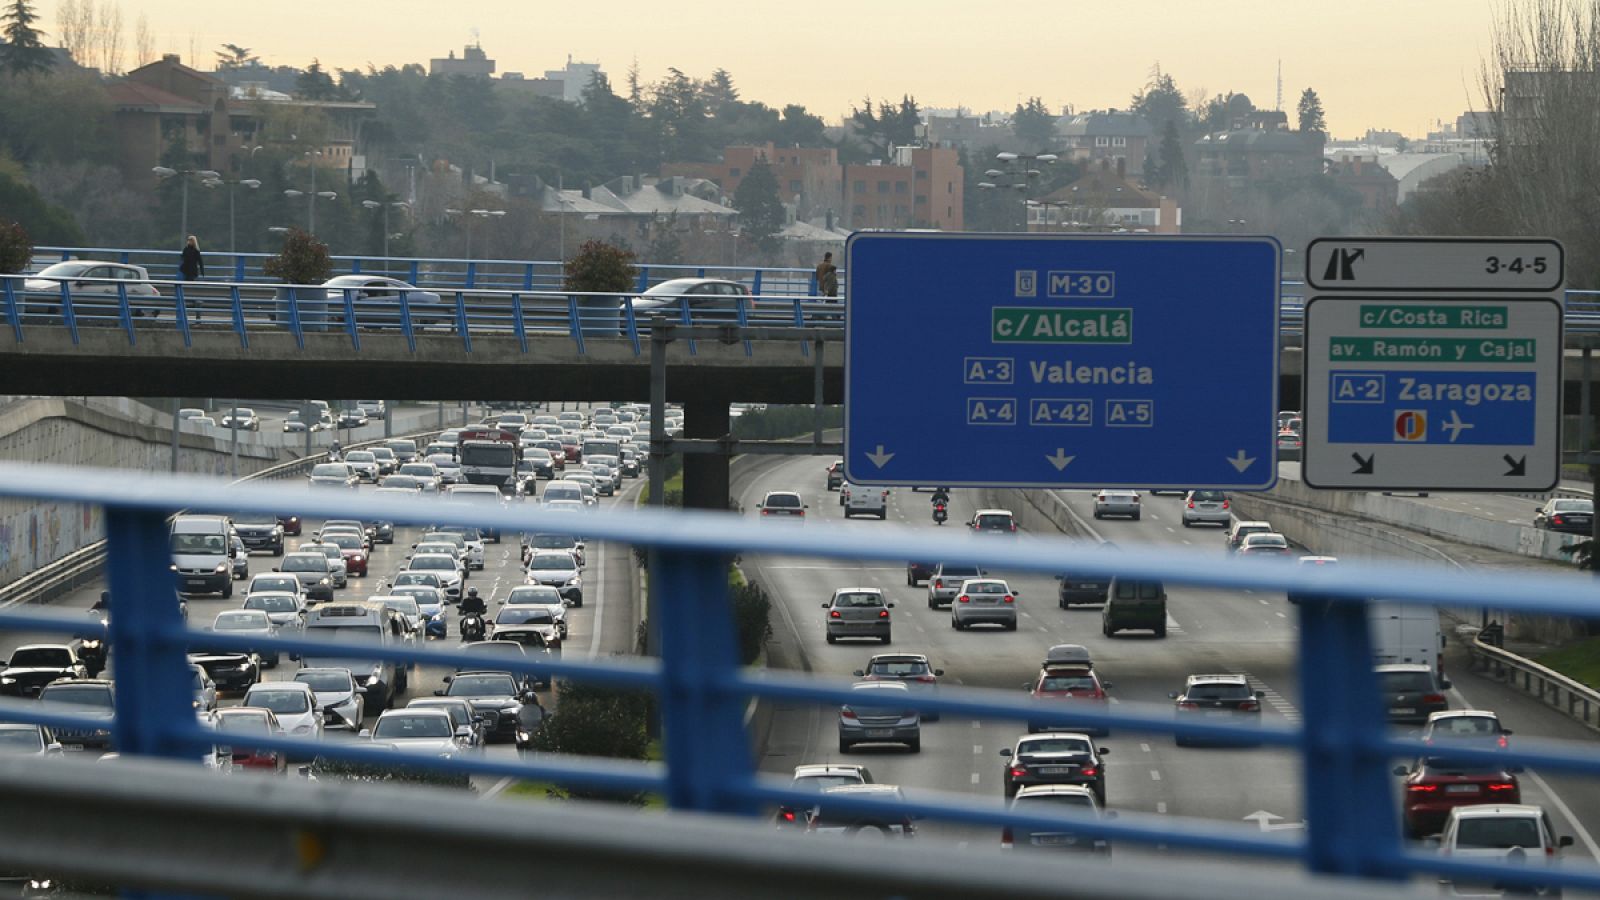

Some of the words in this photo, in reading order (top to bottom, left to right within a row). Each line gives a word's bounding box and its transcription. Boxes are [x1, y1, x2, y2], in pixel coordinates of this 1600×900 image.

[1486, 256, 1547, 274] 3-4-5
[1051, 276, 1111, 294] M-30
[997, 313, 1128, 337] c/Alcalá
[1363, 309, 1448, 325] c/Costa
[1461, 309, 1504, 325] Rica
[1332, 344, 1361, 356] av.
[1373, 341, 1442, 356] Ramón
[1456, 344, 1466, 359] y
[1480, 341, 1533, 360] Cajal
[969, 362, 1010, 380] A-3
[1030, 361, 1153, 384] Valencia
[1338, 379, 1379, 398] A-2
[1398, 378, 1532, 405] Zaragoza
[971, 403, 1012, 420] A-4
[1035, 403, 1089, 421] A-42
[1110, 404, 1149, 421] A-5
